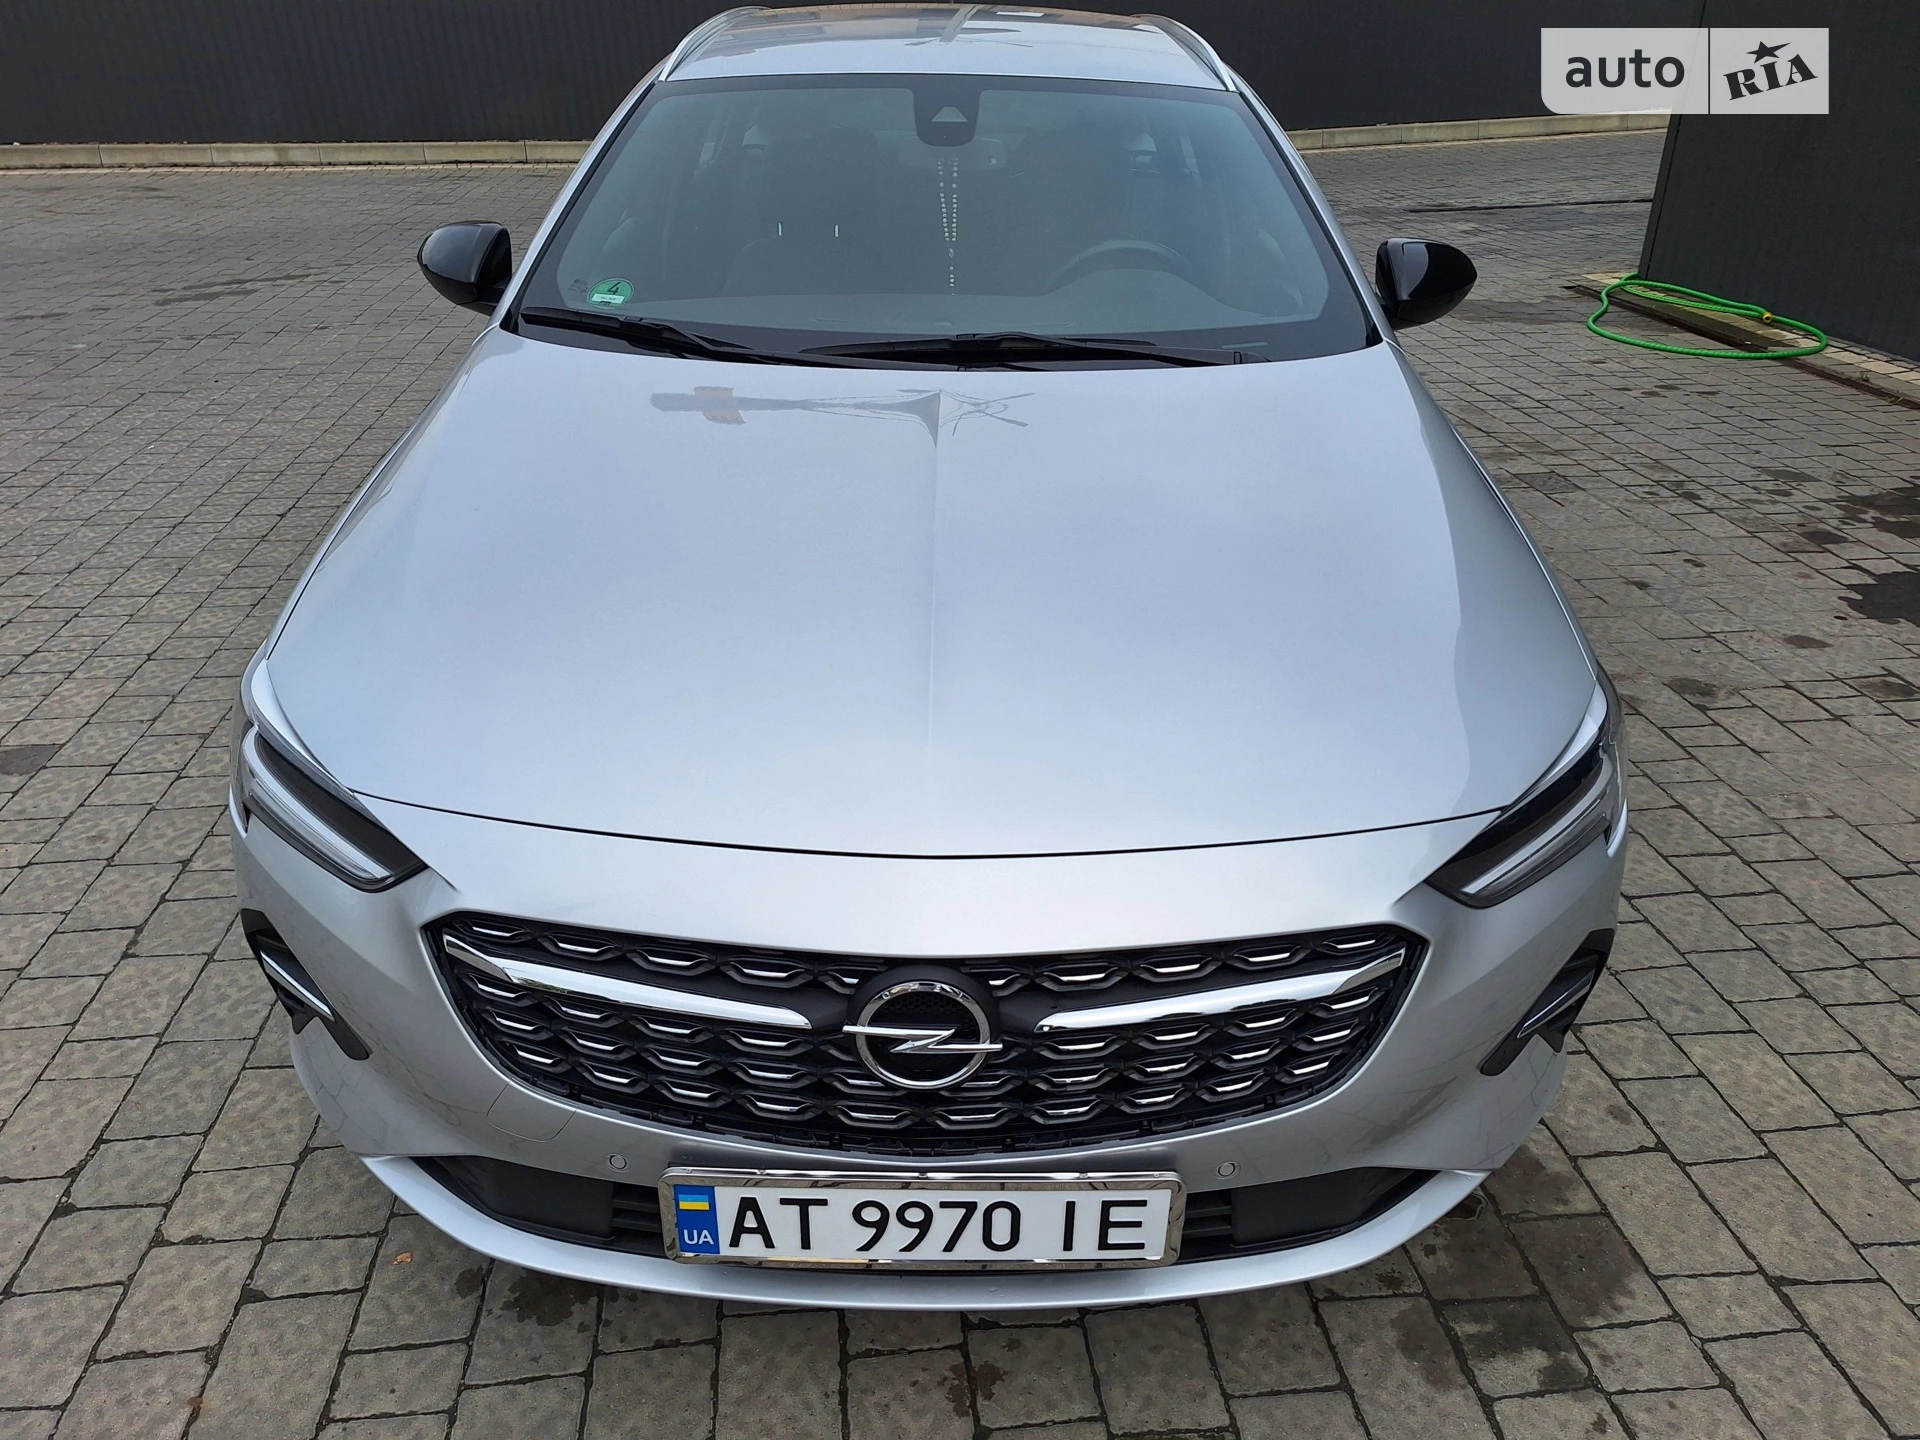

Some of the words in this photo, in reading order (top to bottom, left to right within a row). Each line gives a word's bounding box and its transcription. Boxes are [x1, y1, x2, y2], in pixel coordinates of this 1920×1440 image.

[607, 281, 621, 295] 4
[729, 1196, 829, 1250] AT
[852, 1199, 1021, 1253] 9970
[1062, 1199, 1148, 1252] IE
[684, 1228, 714, 1246] UA
